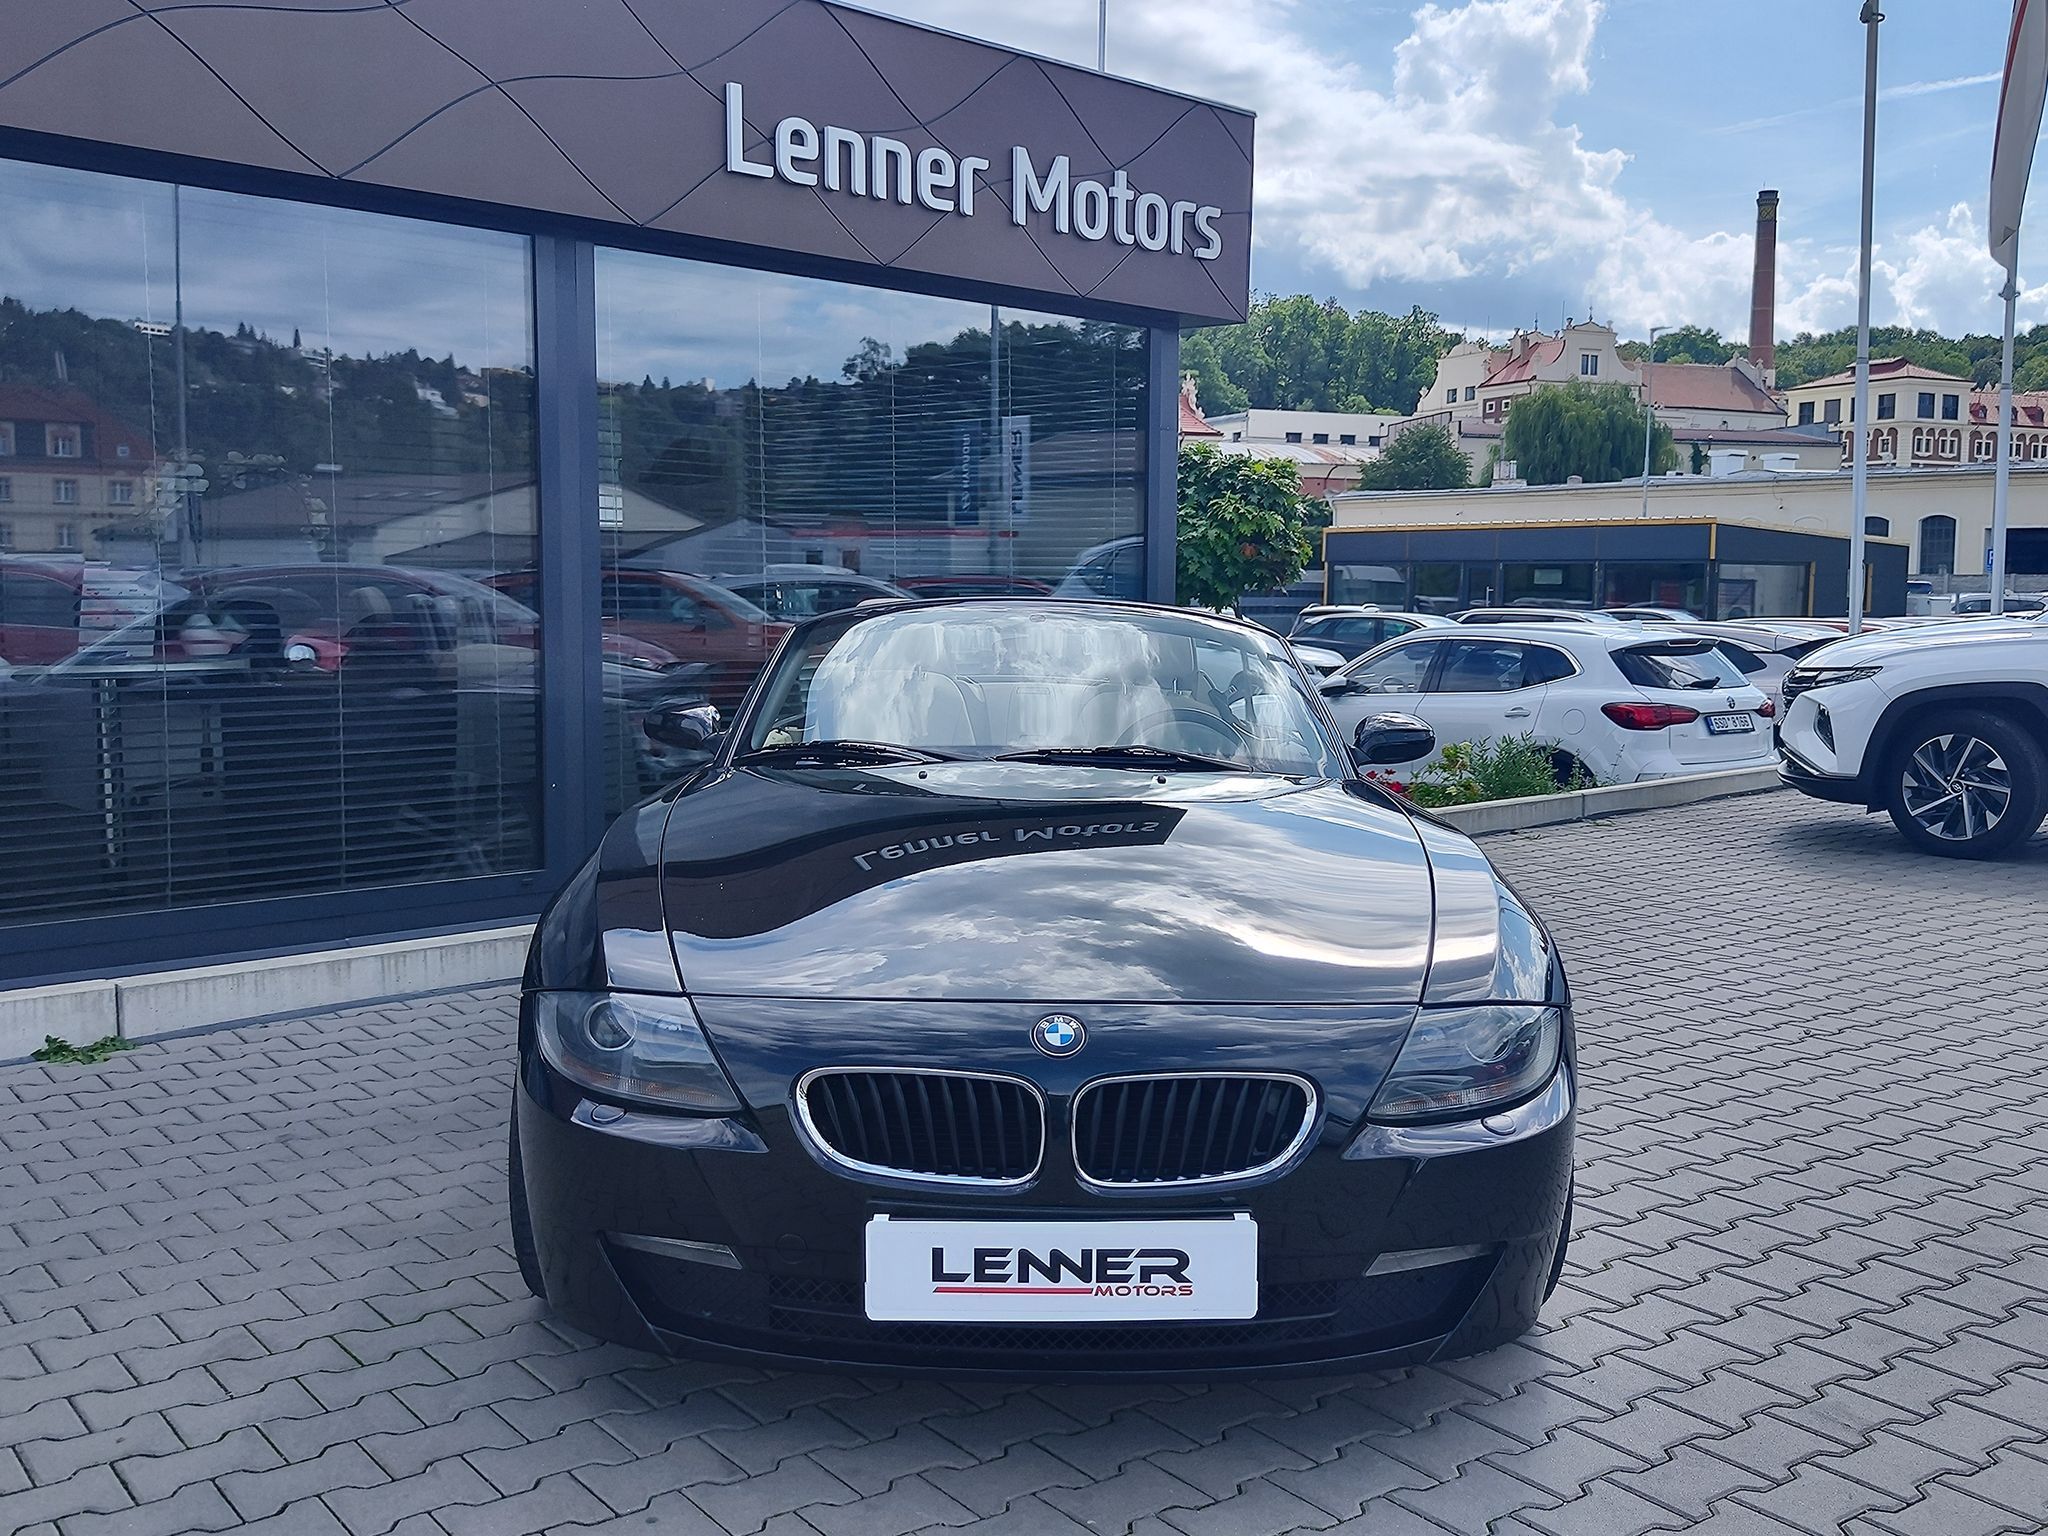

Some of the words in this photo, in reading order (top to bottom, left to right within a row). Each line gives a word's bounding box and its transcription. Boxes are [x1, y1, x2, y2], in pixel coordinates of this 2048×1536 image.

[725, 82, 990, 217] Lenner
[1011, 145, 1223, 260] Motors
[1040, 1015, 1079, 1030] BMW
[931, 1246, 1192, 1284] LENNER
[1093, 1284, 1193, 1297] MOTORS
